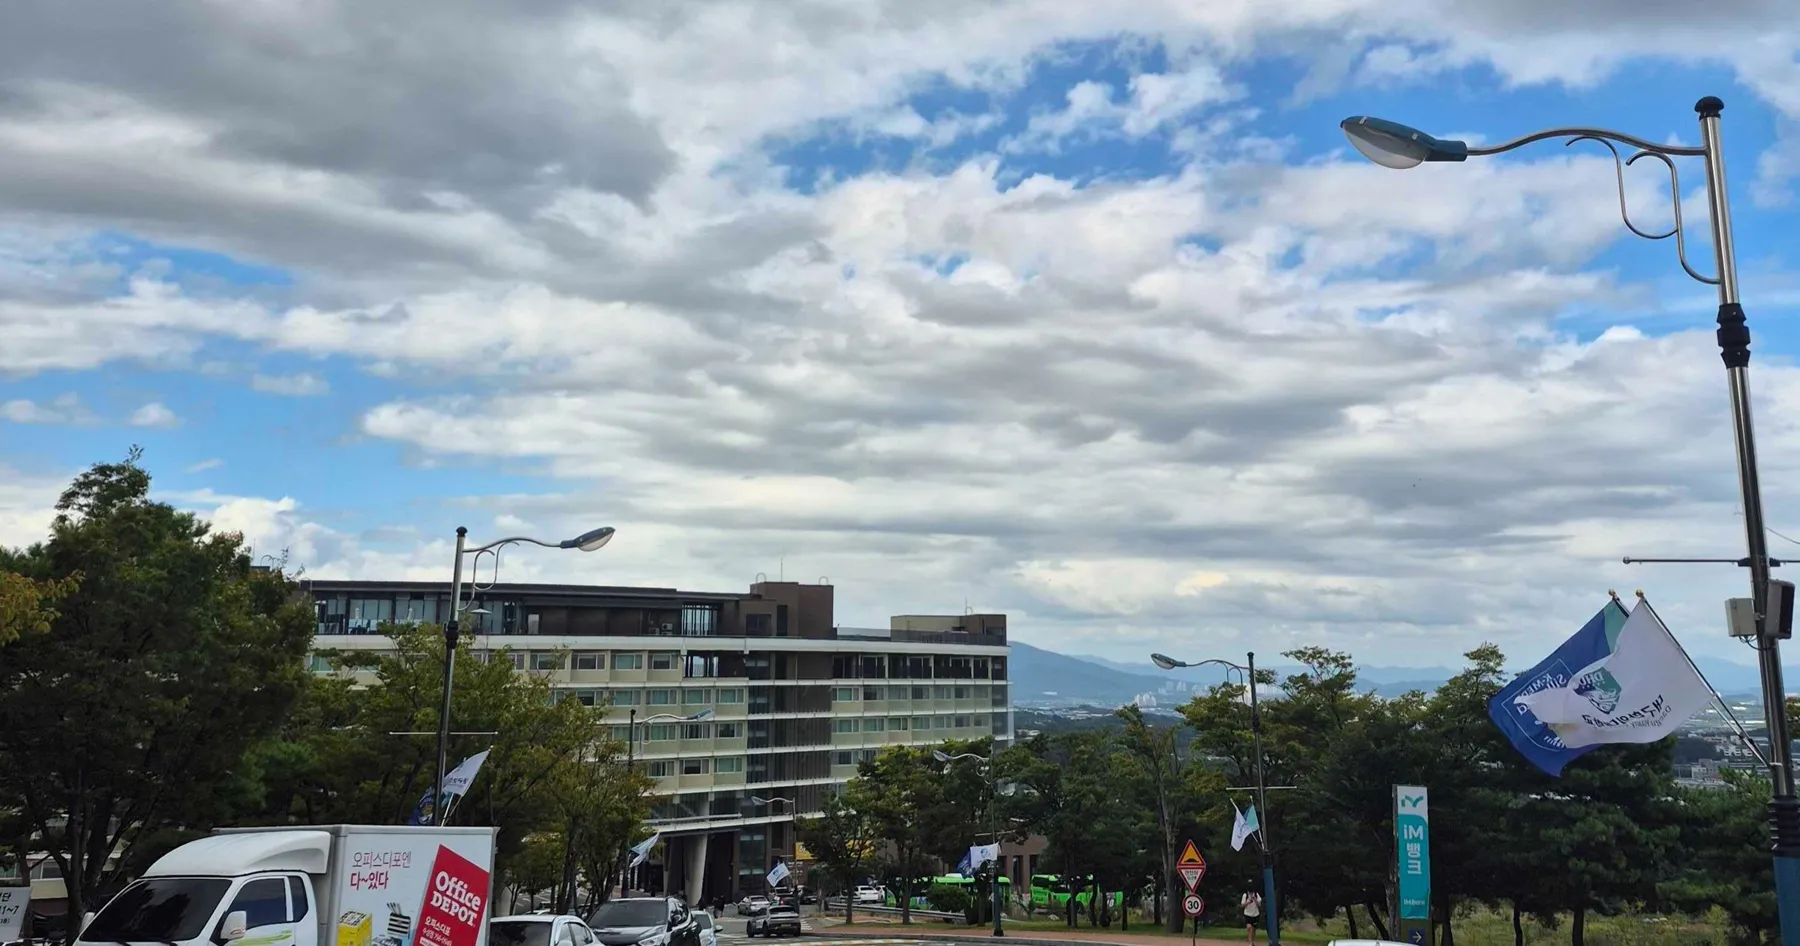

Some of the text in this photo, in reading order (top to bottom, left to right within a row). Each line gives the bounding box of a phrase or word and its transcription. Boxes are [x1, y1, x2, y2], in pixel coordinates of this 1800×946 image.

[352, 851, 412, 869] 오피스디포엔
[350, 871, 389, 890] 다~있다
[435, 870, 481, 911] Office
[430, 890, 478, 926] DEPOT
[1187, 901, 1200, 910] 30
